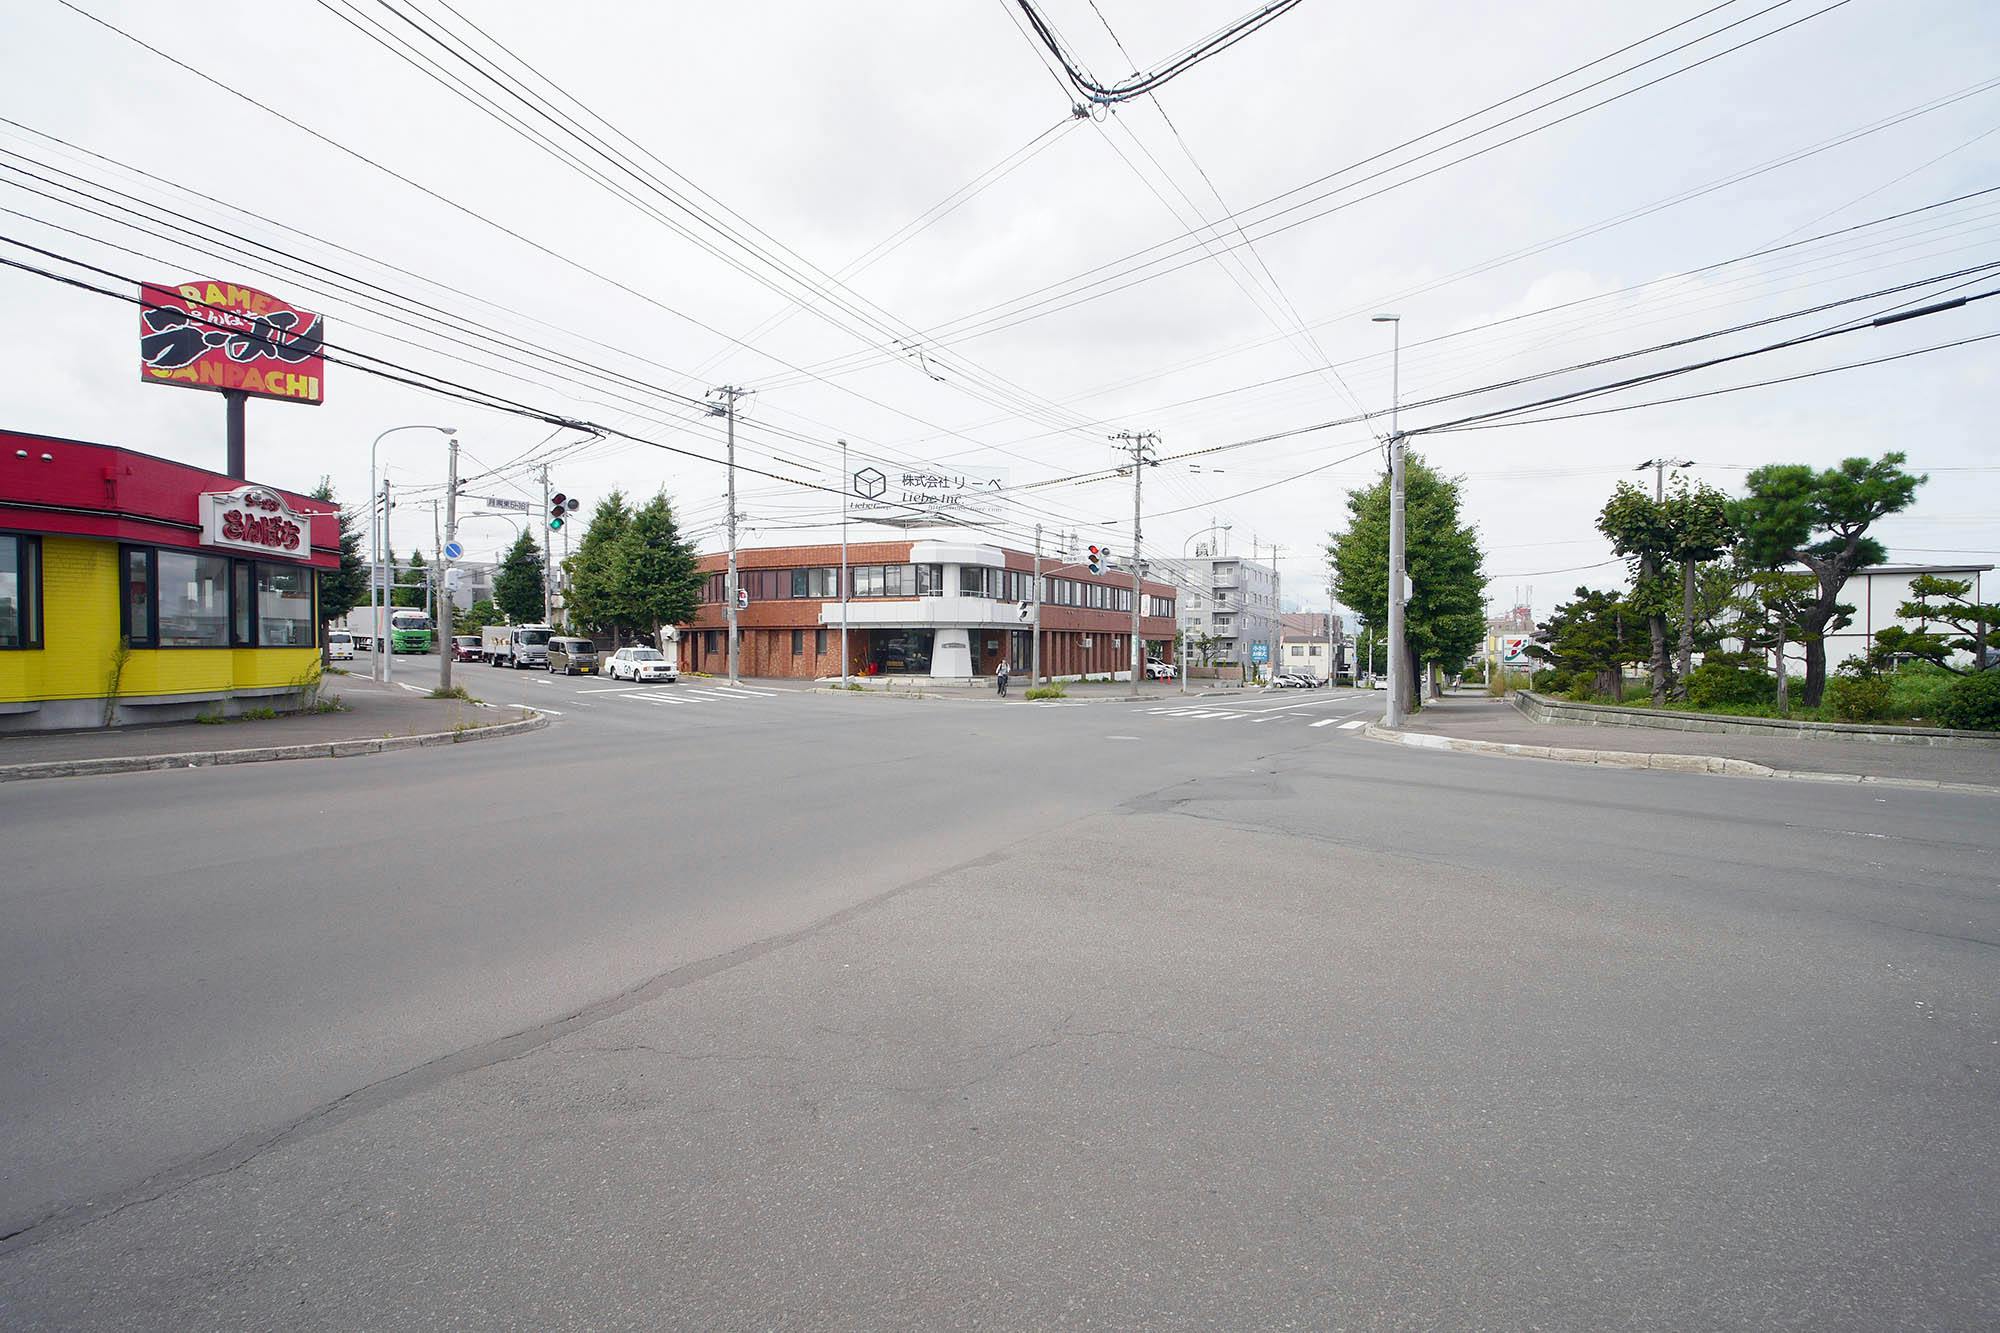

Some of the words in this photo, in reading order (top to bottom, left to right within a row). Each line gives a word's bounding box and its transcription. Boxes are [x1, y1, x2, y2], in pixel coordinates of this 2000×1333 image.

[179, 283, 278, 314] RAME
[141, 305, 323, 369] ラーメン
[902, 492, 938, 503] Liebe
[940, 493, 965, 505] Inc.
